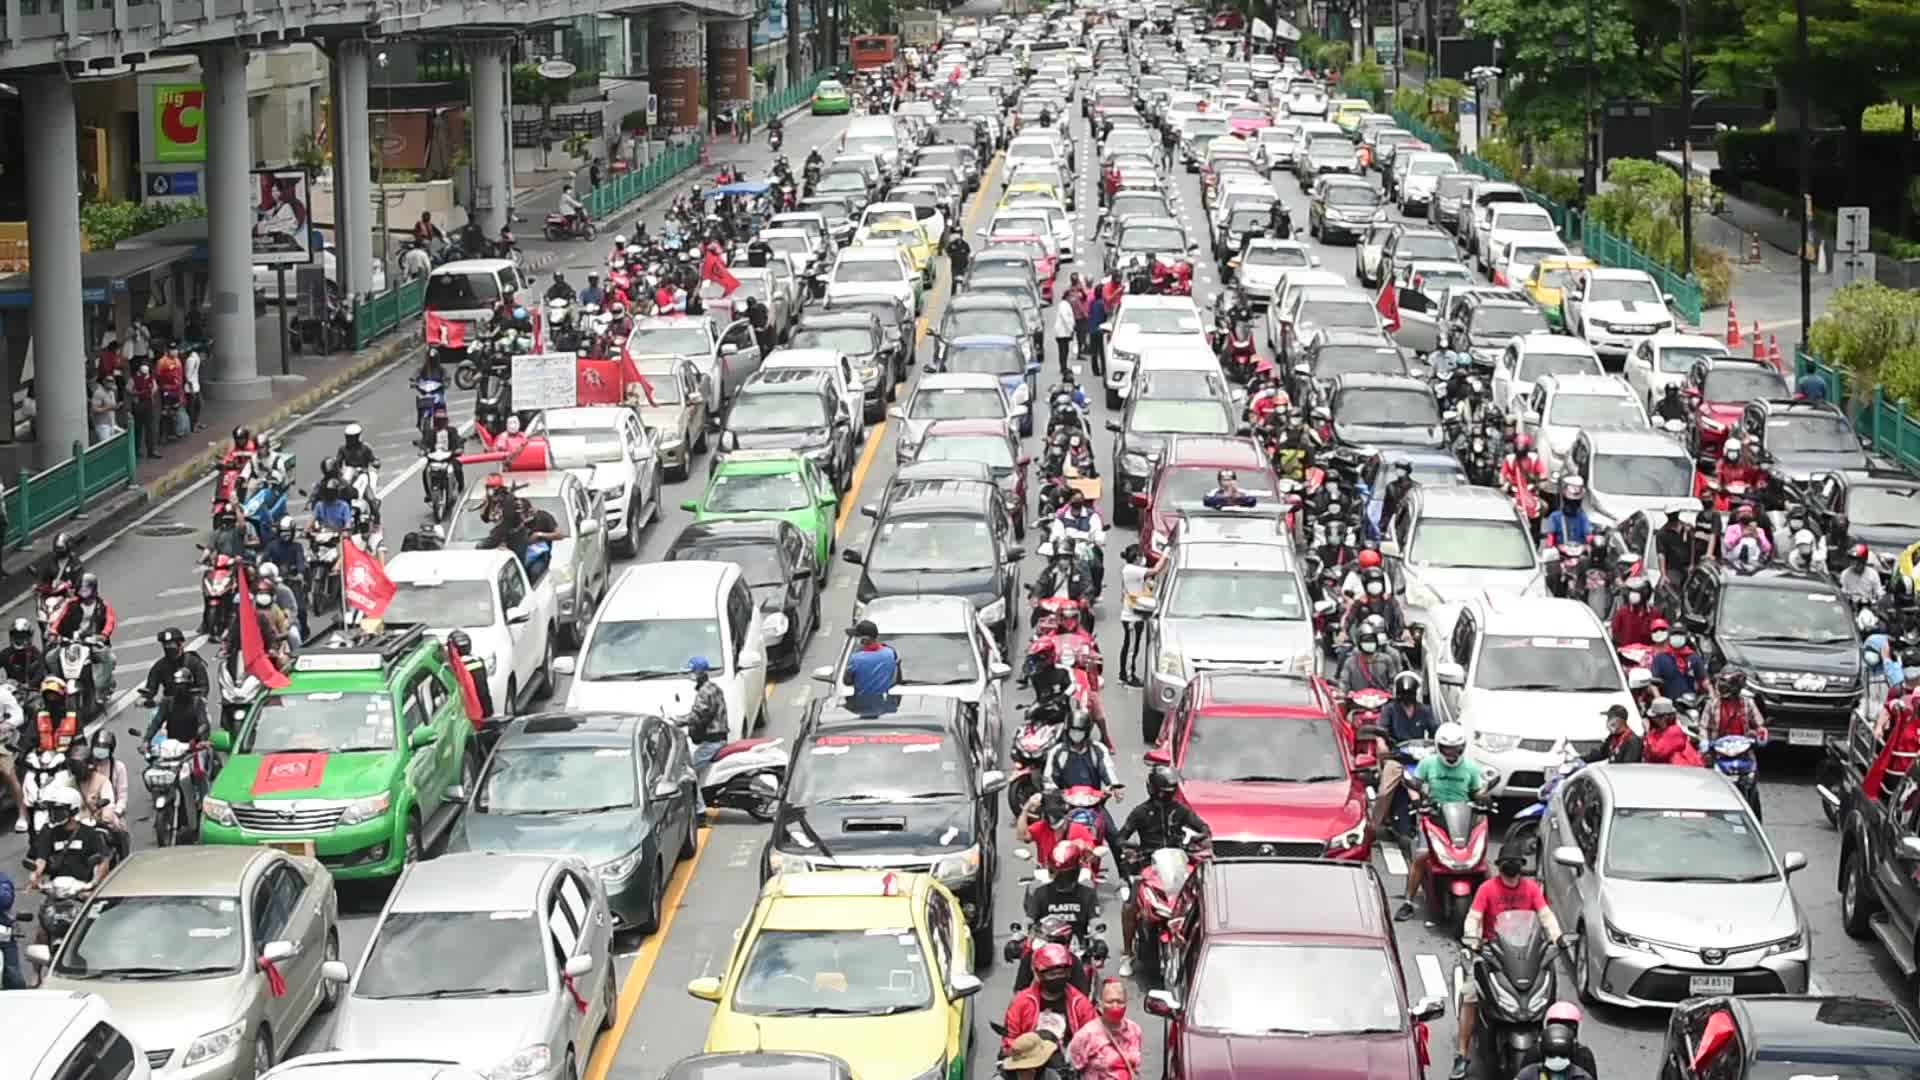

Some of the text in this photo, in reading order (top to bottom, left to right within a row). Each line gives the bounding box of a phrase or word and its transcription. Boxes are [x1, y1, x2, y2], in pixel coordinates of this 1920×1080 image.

[158, 89, 184, 107] Big
[161, 90, 204, 144] C
[1048, 903, 1080, 912] PLASTIC
